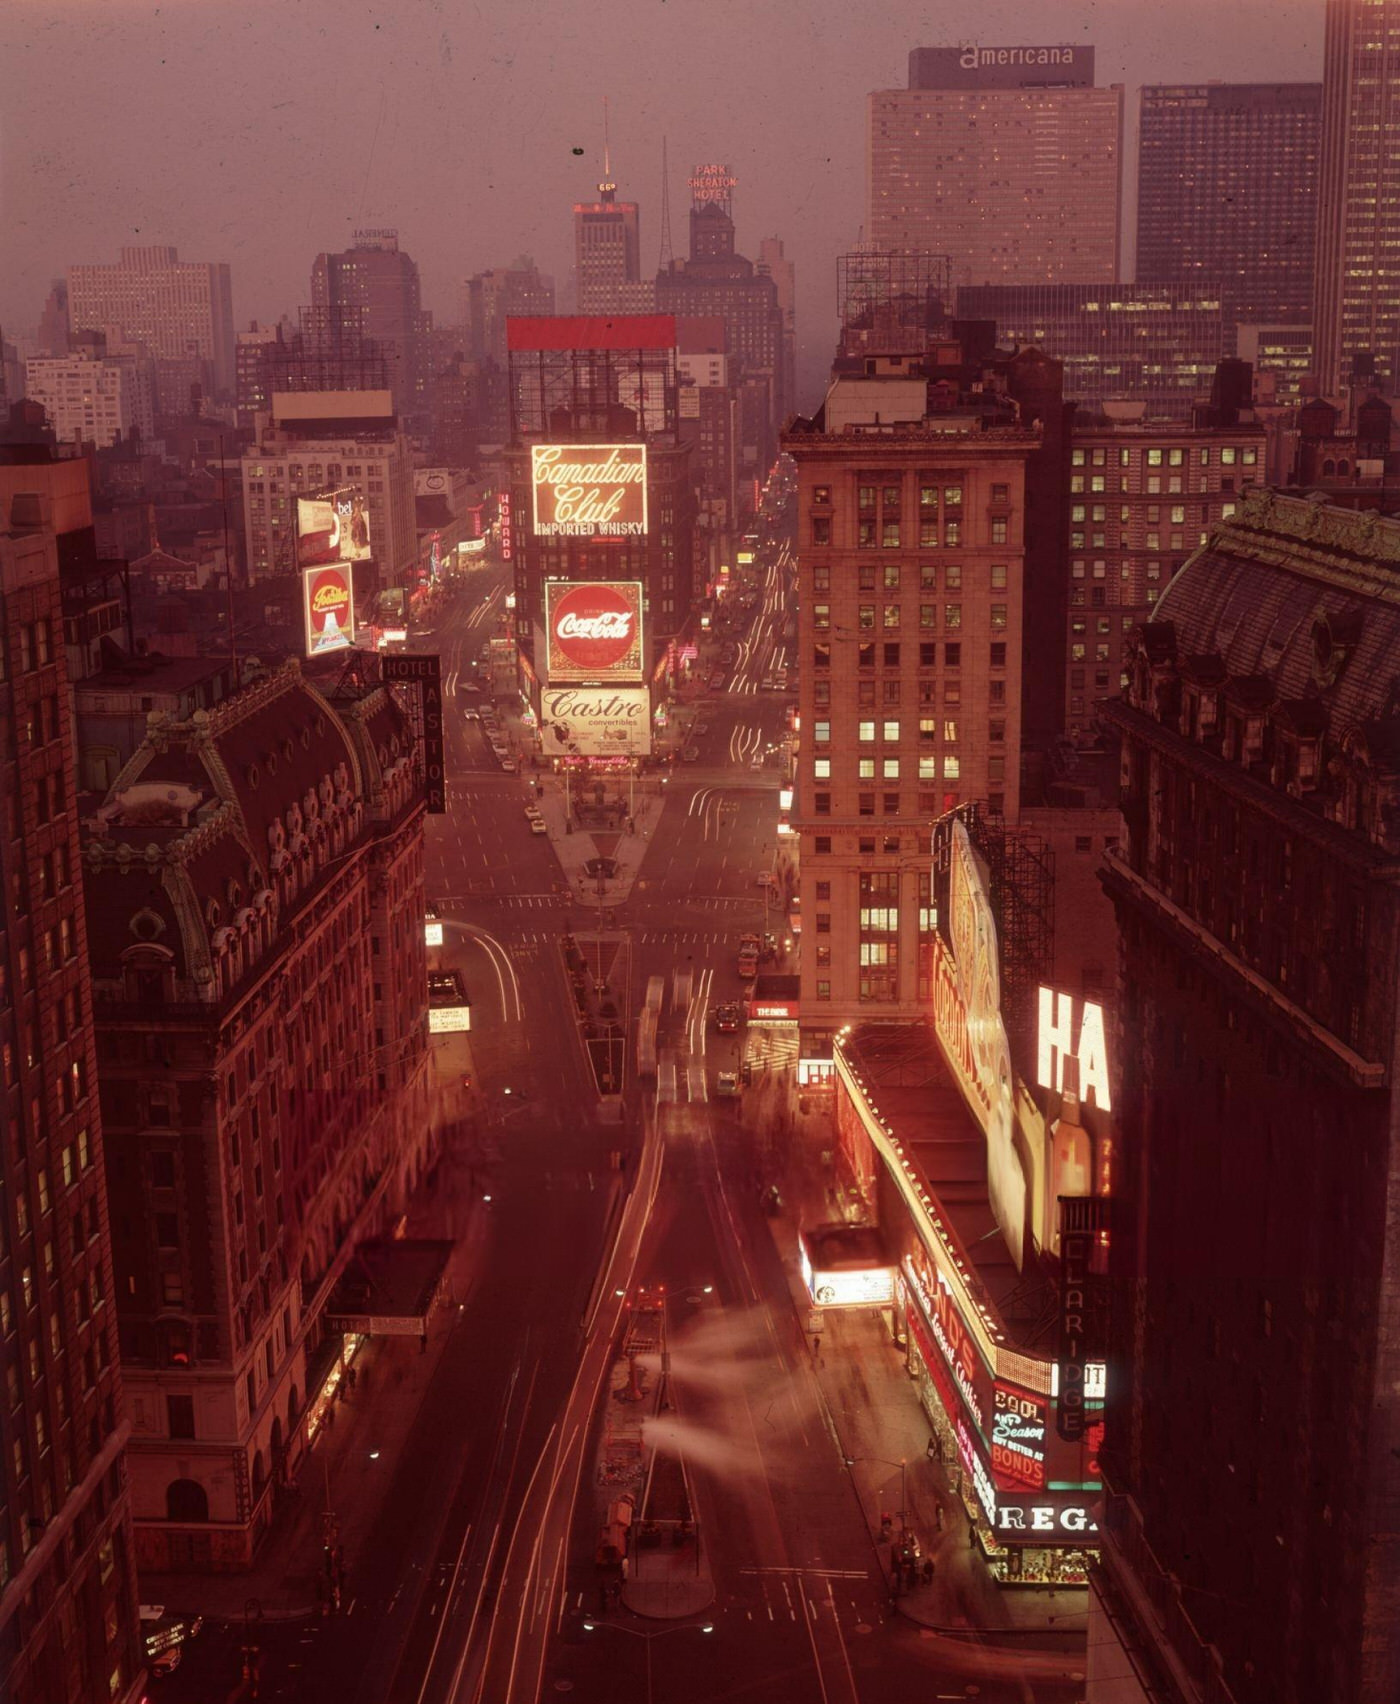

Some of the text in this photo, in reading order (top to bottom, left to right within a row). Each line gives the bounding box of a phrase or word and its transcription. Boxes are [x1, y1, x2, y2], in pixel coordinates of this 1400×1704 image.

[959, 45, 1073, 69] americana
[696, 164, 726, 175] PARK
[694, 189, 729, 200] HOTEL
[535, 448, 645, 484] Canadian
[554, 484, 626, 523] Club
[501, 494, 511, 559] HOWARD
[537, 522, 643, 535] IMPORTED WHISKY
[387, 661, 437, 676] HOTEL
[543, 690, 646, 717] Castro
[588, 718, 638, 726] convertibles
[426, 687, 442, 806] ASTOR
[1065, 1239, 1084, 1431] CLARIDGE
[992, 1414, 1045, 1441] Season
[993, 1444, 1044, 1479] BOND'S
